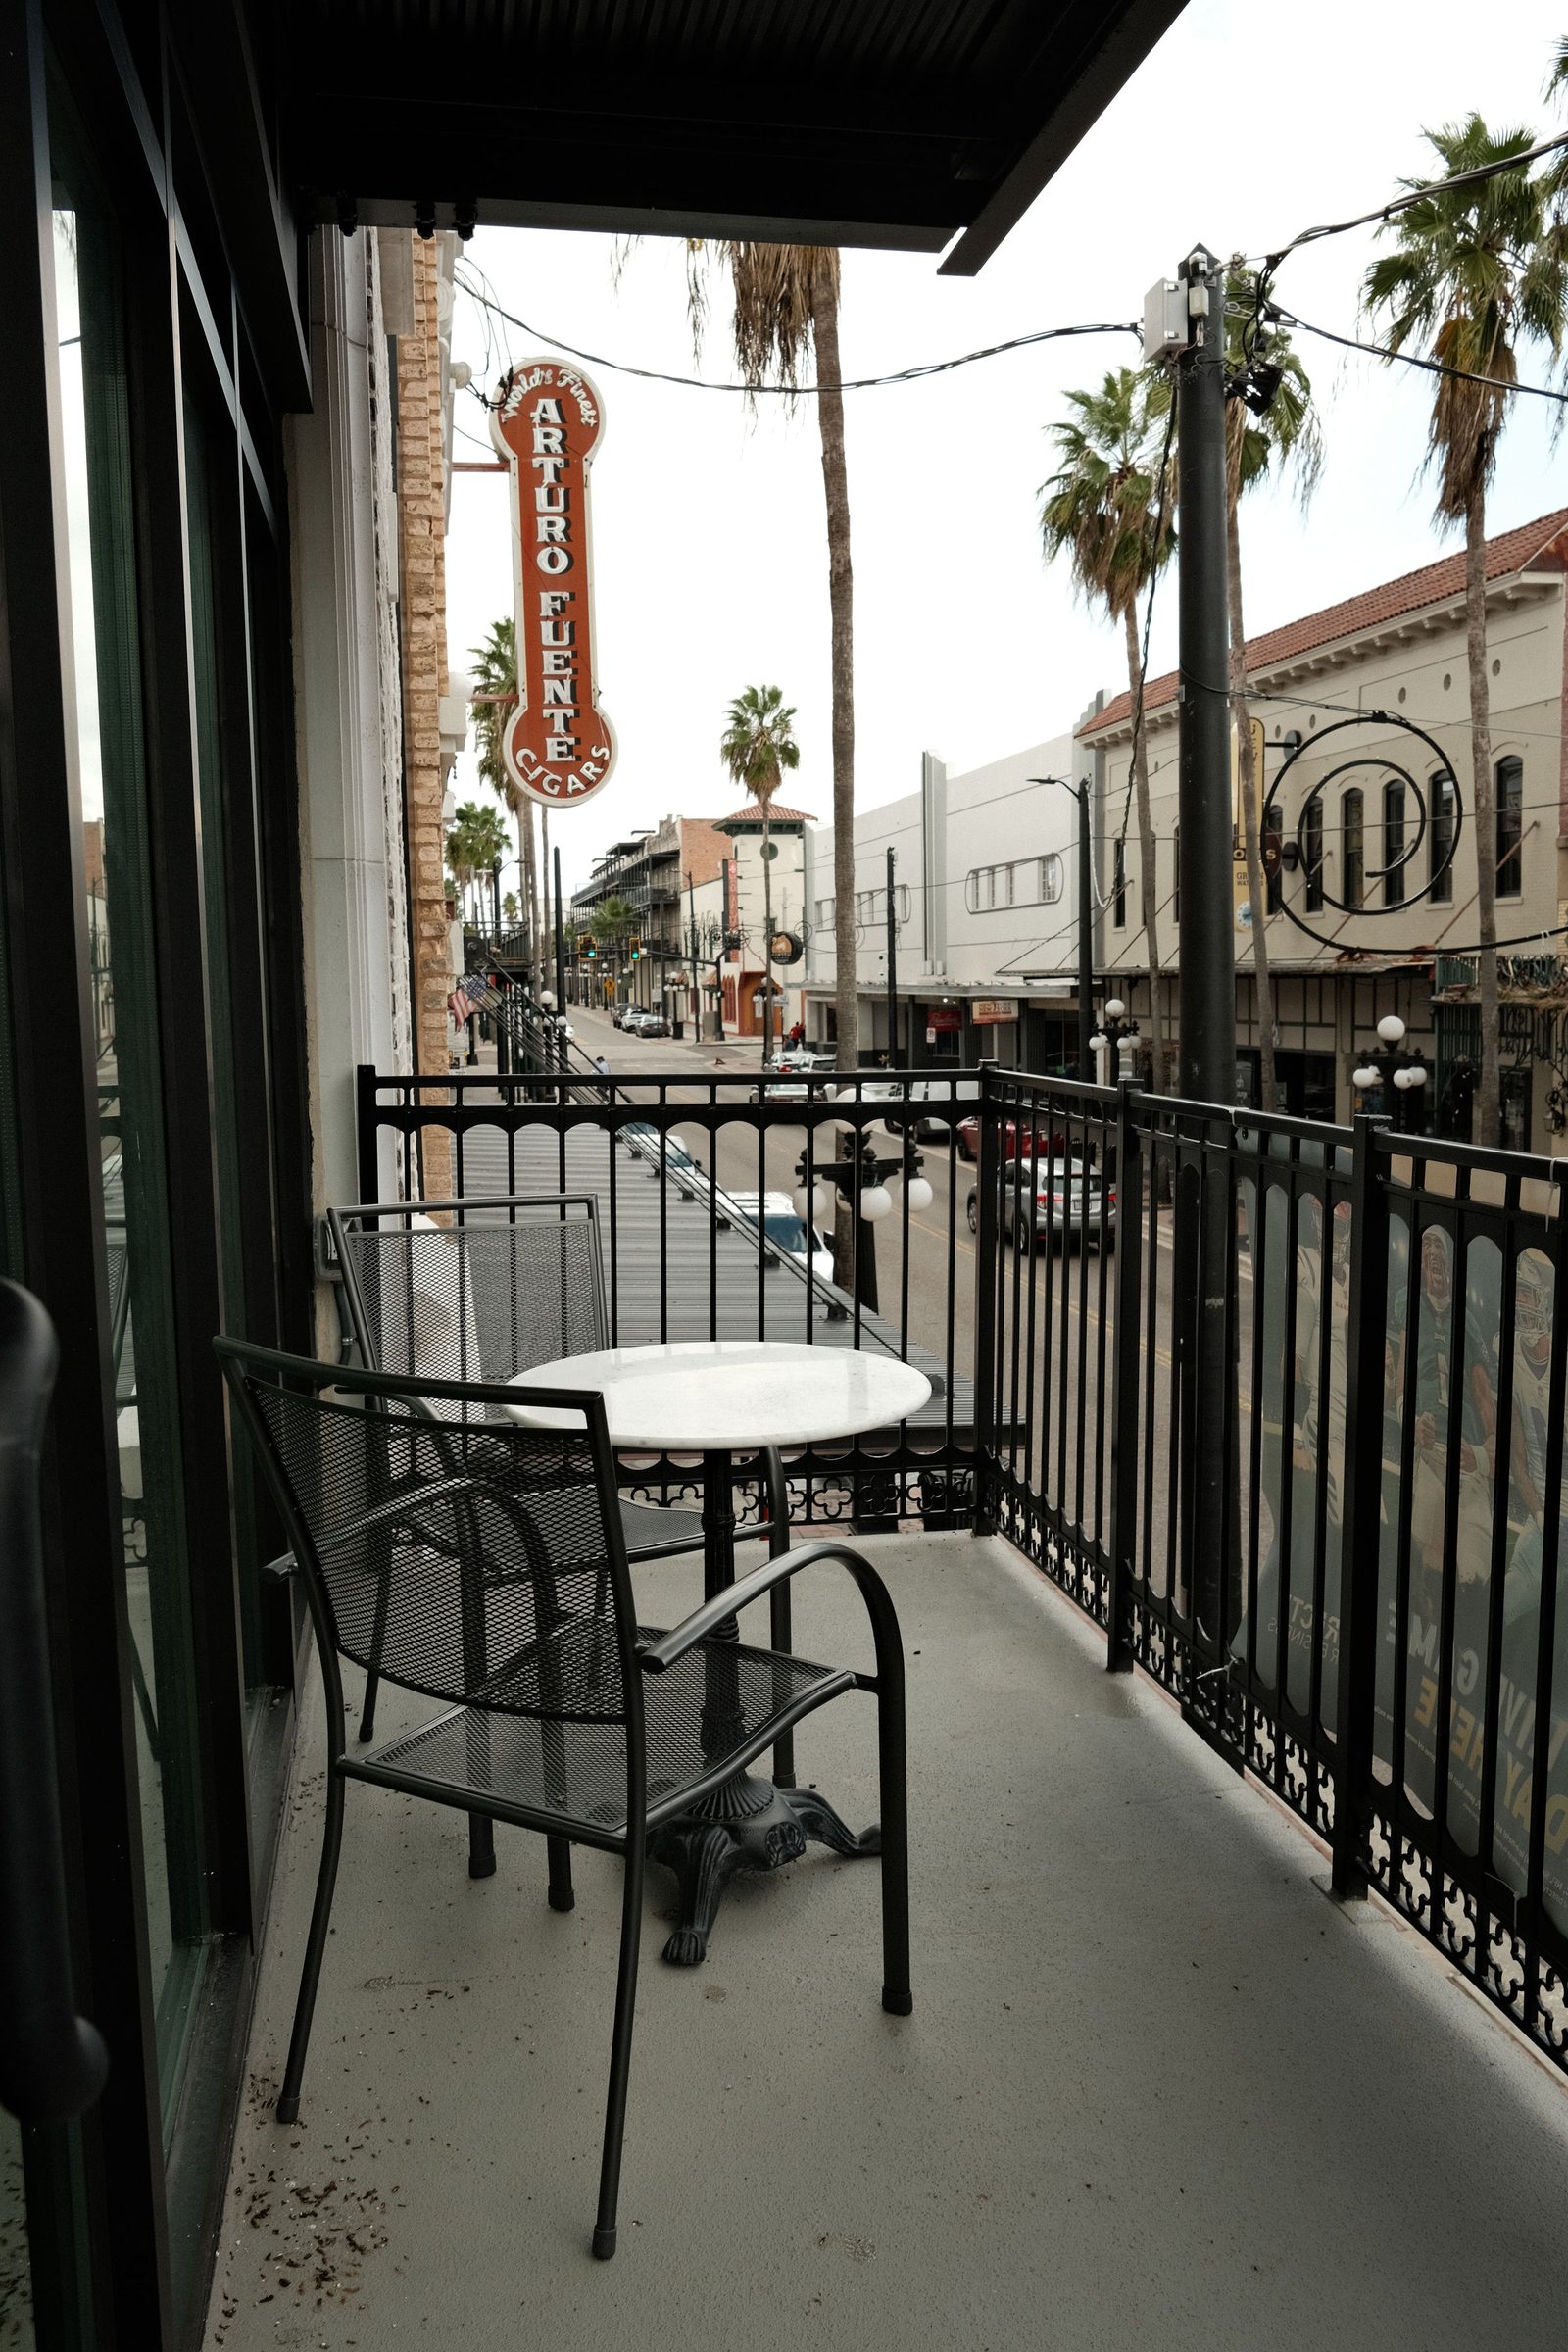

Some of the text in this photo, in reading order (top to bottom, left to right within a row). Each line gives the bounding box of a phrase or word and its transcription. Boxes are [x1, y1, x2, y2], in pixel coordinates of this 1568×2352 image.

[557, 368, 598, 427] Finest
[530, 398, 579, 762] ARTURO FUENTE
[515, 744, 610, 796] CIGARS
